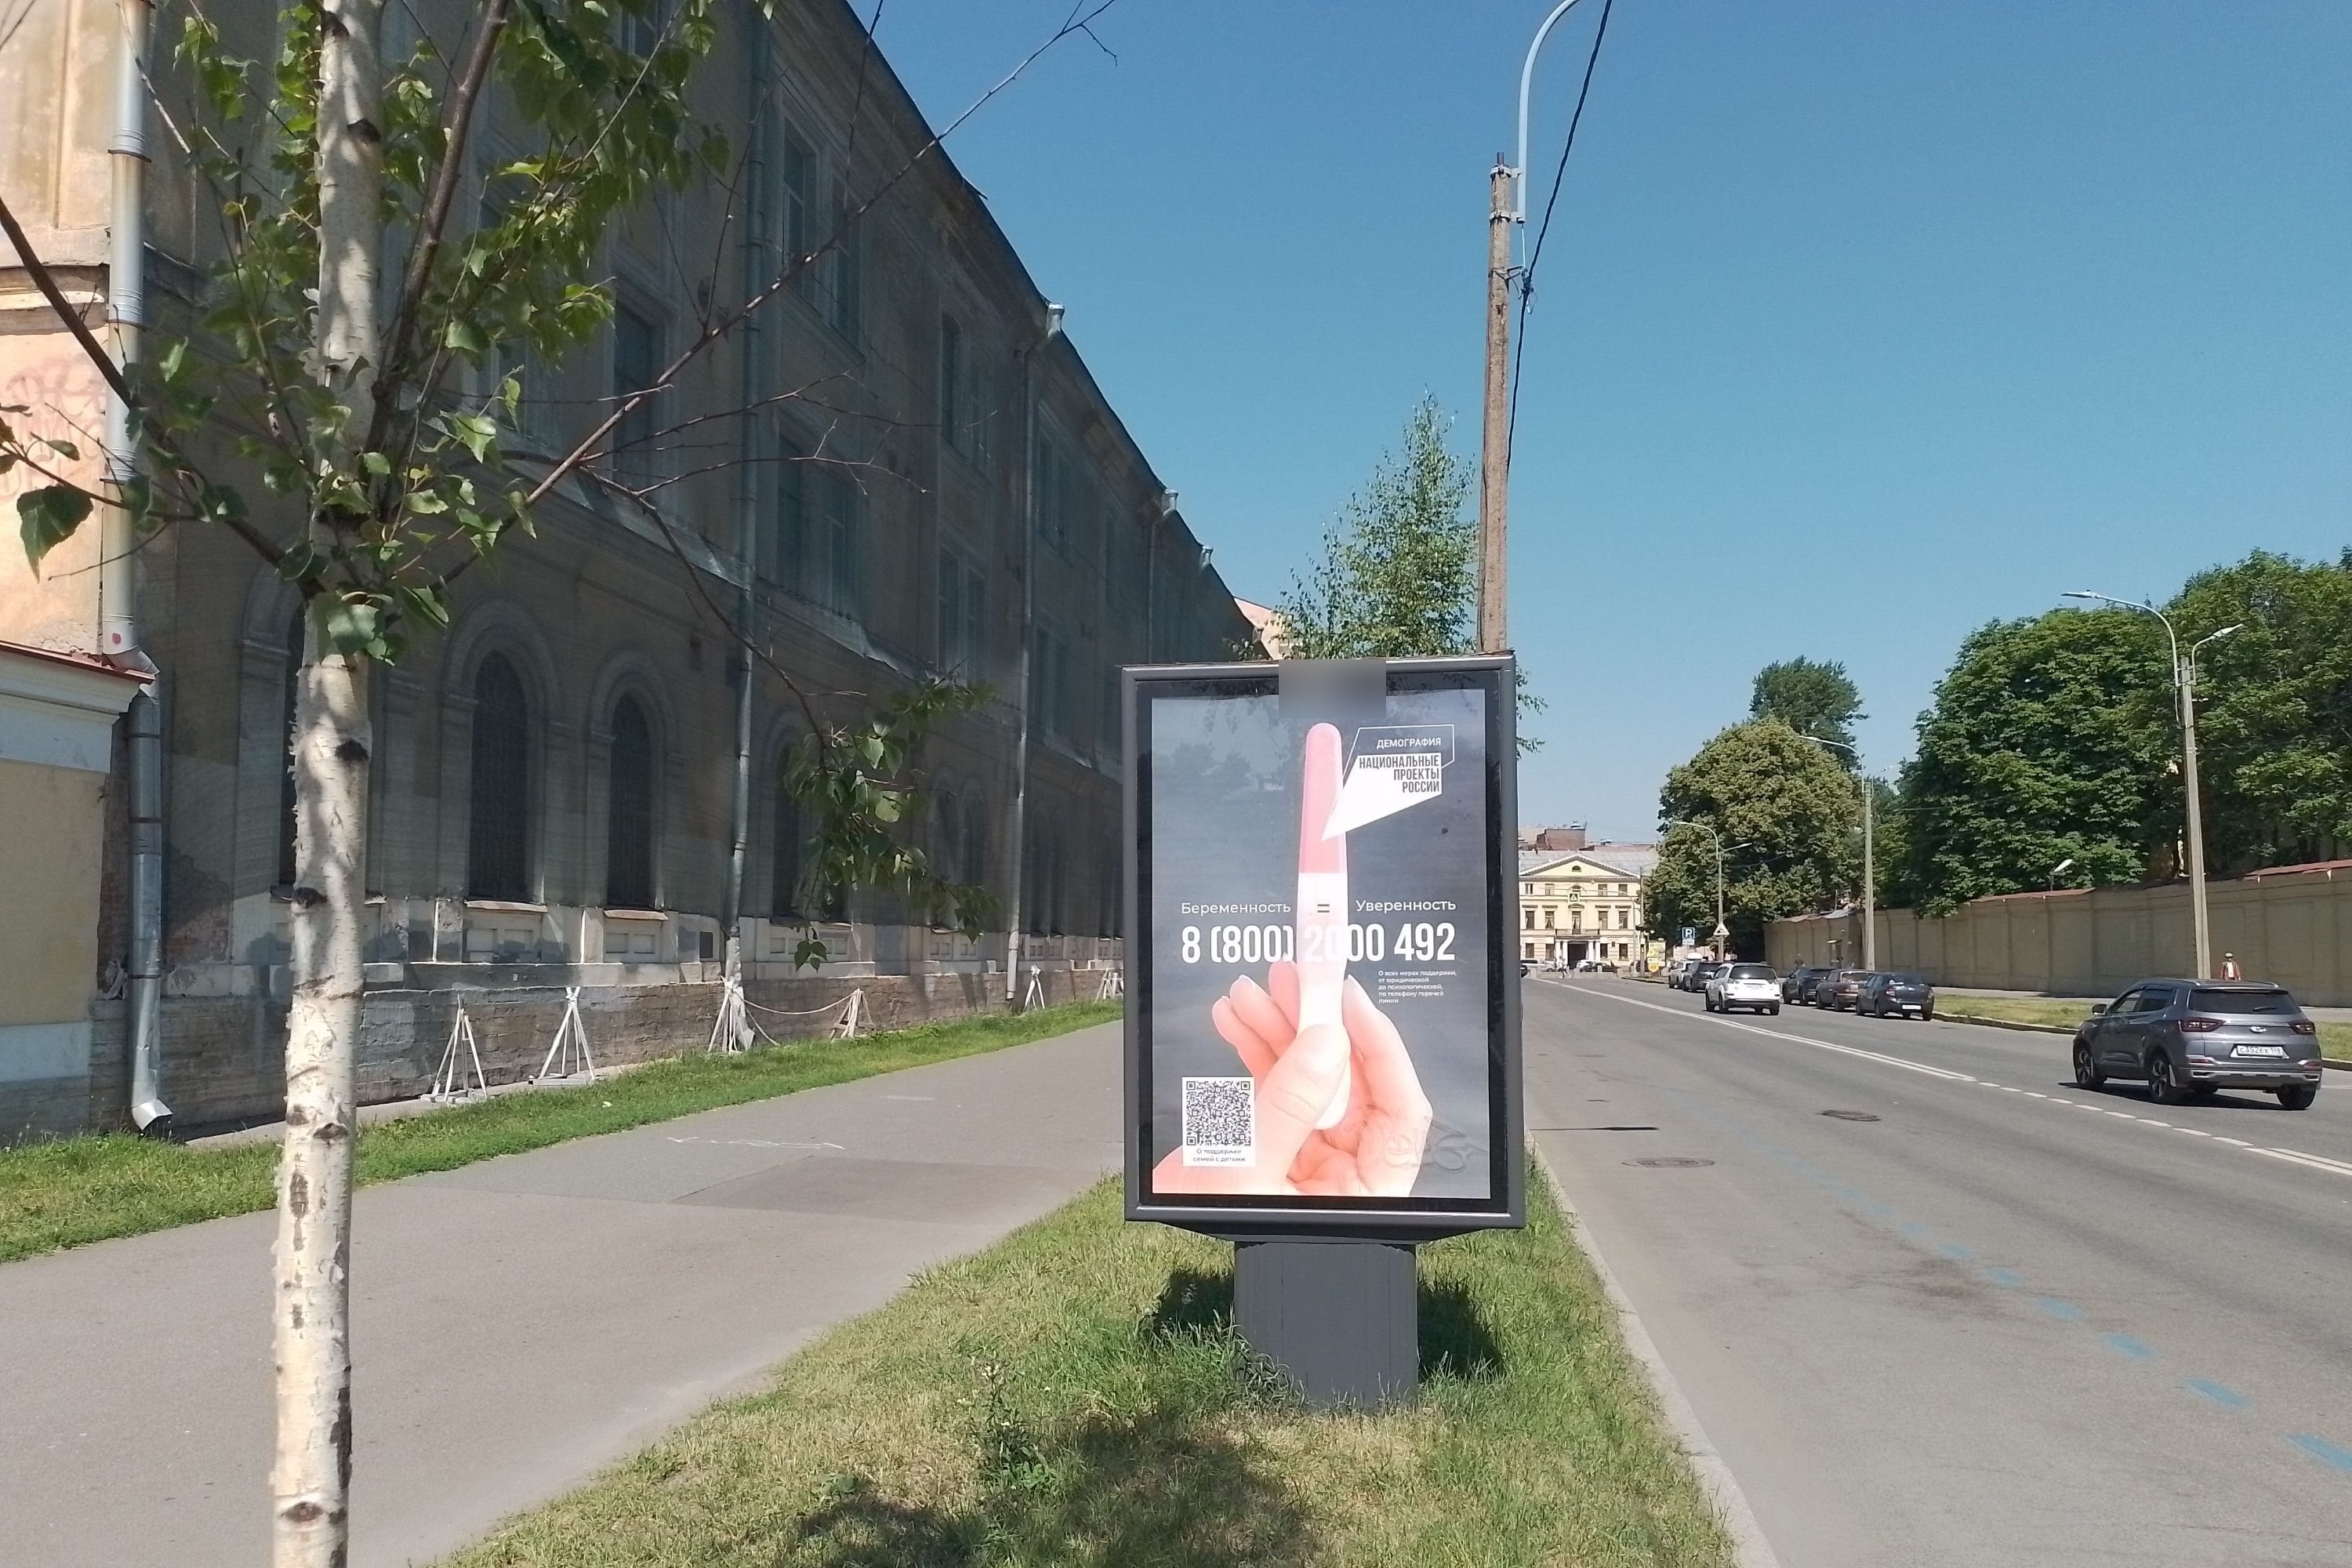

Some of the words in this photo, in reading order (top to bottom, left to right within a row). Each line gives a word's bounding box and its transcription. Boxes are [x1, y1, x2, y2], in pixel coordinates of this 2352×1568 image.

[1377, 738, 1441, 750] ДЕМОГРАФИЯ
[1359, 755, 1439, 770] НАЦИОНАЛЬНЫЕ
[1393, 768, 1439, 781] ПРОЕКТЫ
[1402, 781, 1439, 793] РОССИИ
[1181, 902, 1291, 916] Беременность
[1356, 899, 1457, 913] Уверенность
[1181, 925, 1201, 964] 8
[1210, 924, 1294, 964] (800)
[1393, 922, 1456, 961] 492
